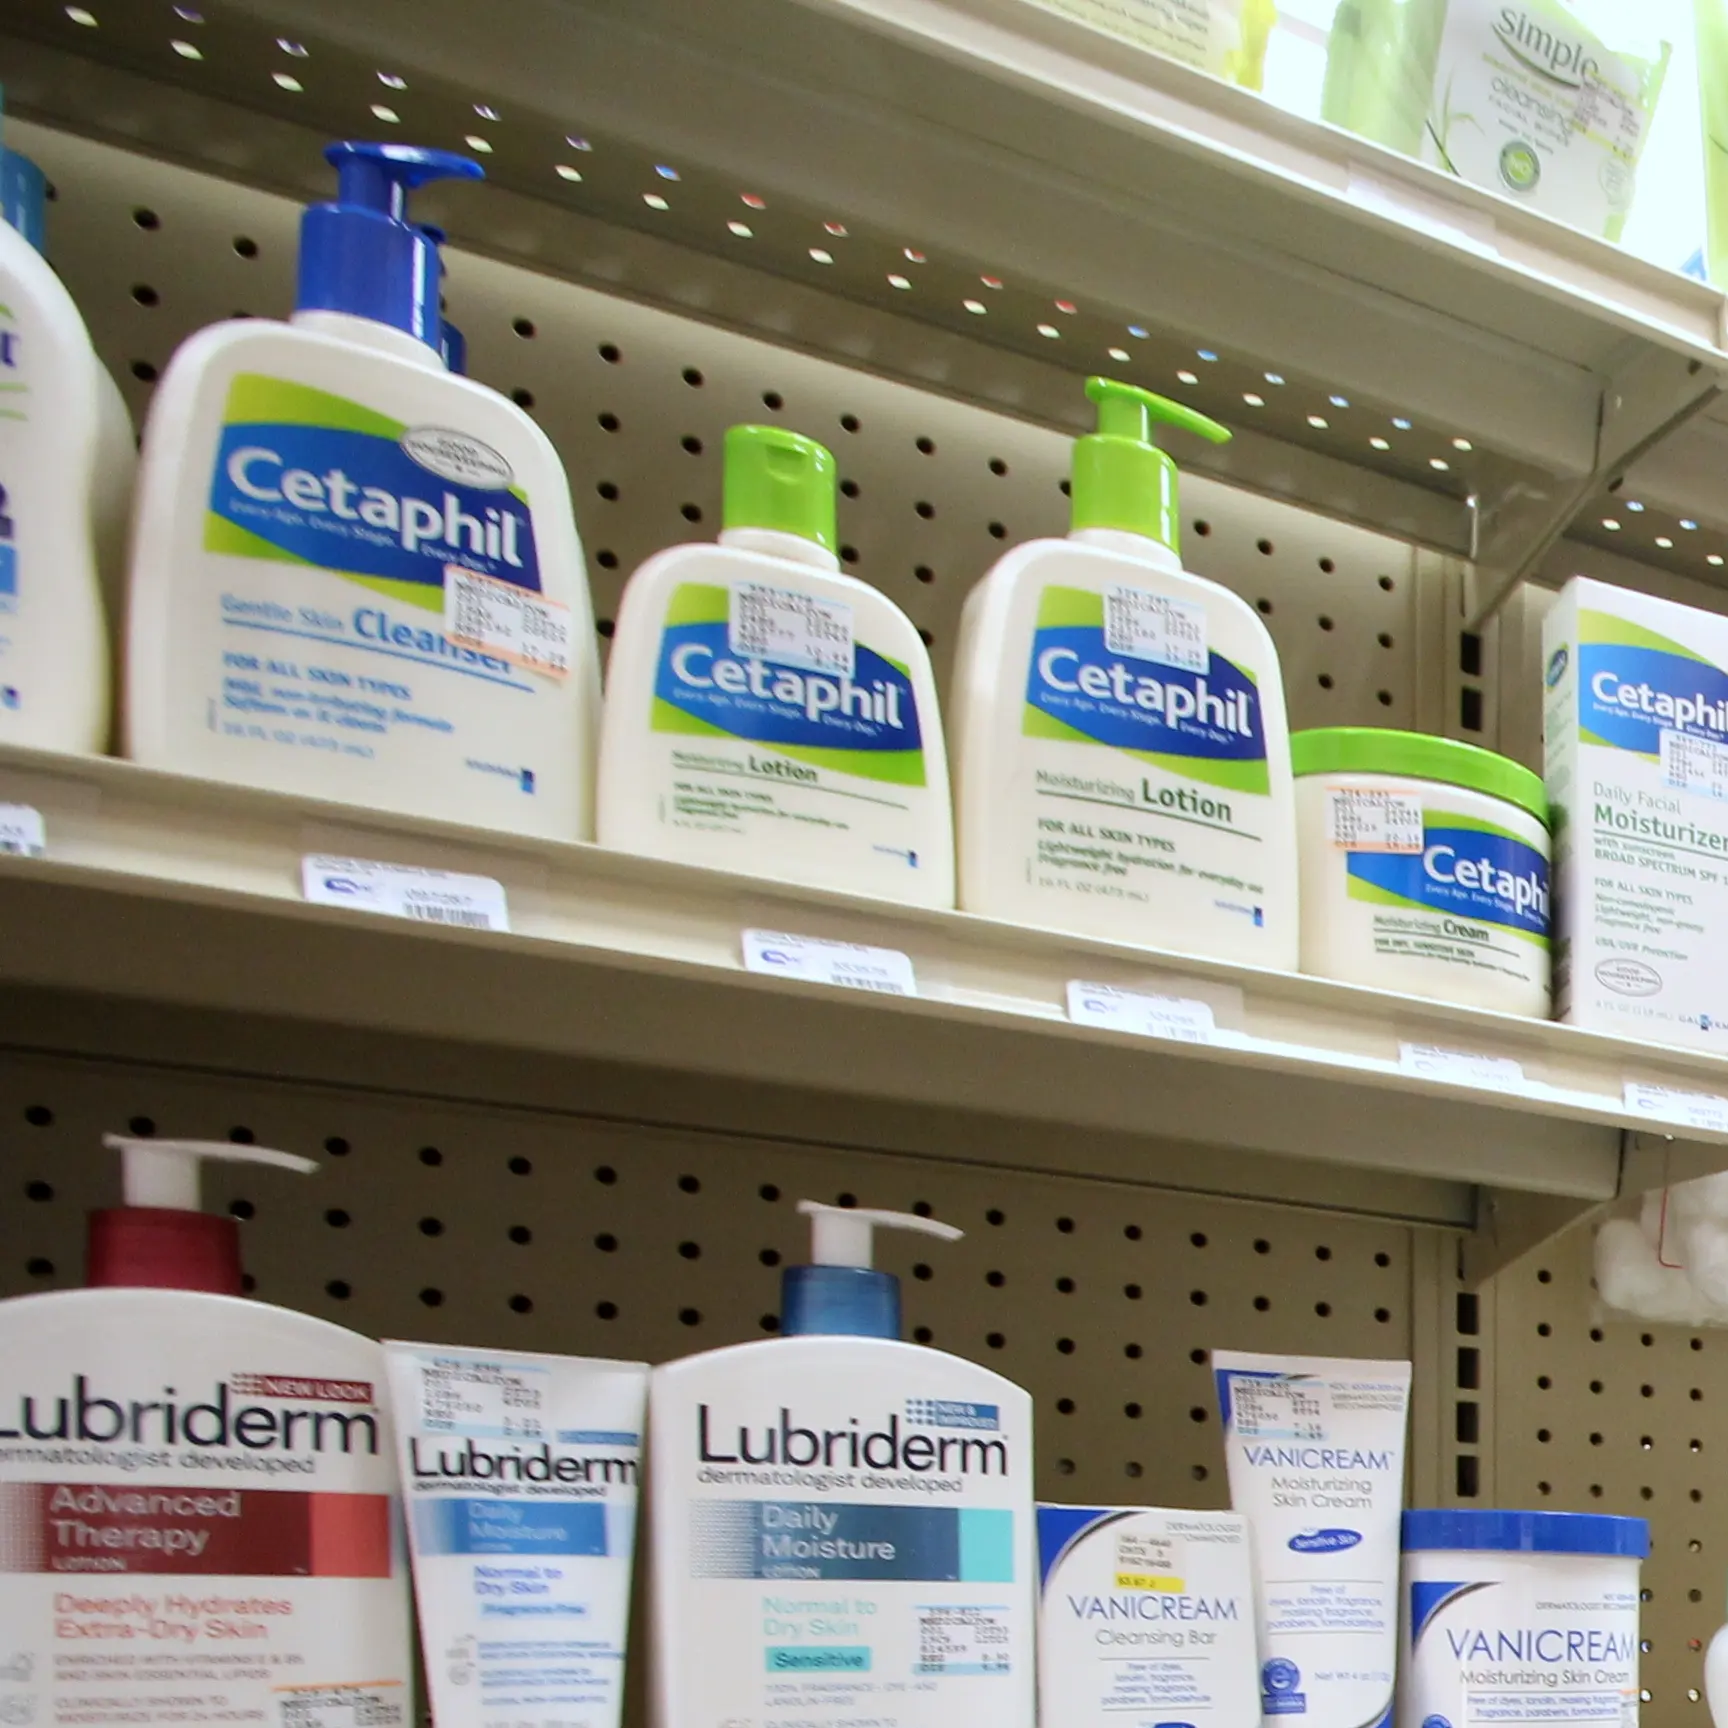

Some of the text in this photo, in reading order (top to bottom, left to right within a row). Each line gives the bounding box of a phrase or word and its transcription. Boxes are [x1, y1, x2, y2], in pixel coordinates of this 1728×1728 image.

[1499, 9, 1599, 92] Simple
[226, 444, 525, 568] Cetaphil
[670, 642, 904, 731] Cetaphil
[1037, 646, 1254, 738] Cetaphil
[749, 753, 819, 783] Lotion
[1035, 769, 1234, 823] Moisturizing Lotion
[1593, 782, 1682, 816] Daily Facial
[1037, 817, 1176, 853] FOR ALL SKIN TYPES
[1594, 849, 1636, 869] BROAD
[1637, 855, 1697, 879] SPECTRUM
[1699, 867, 1719, 883] SPF
[1443, 917, 1490, 942] Cream
[0, 1373, 380, 1456] ubriderm
[697, 1403, 1009, 1478] Lubriderm
[408, 1434, 640, 1488] Lubriderm
[1243, 1446, 1391, 1471] VANICREAM
[696, 1466, 964, 1494] dermatologist developed
[49, 1485, 243, 1520] Advanced
[1271, 1492, 1373, 1510] Skin Cream
[761, 1506, 839, 1535] Daily
[51, 1519, 211, 1556] Therapy
[760, 1531, 896, 1560] Moisture
[54, 1592, 295, 1620] Deeply Hydrates
[762, 1595, 878, 1617] Normal to
[1067, 1594, 1240, 1623] VANICREAM
[54, 1618, 270, 1643] Extra-Dry Skin
[762, 1616, 860, 1639] Dry Skin
[1095, 1628, 1219, 1649] Cleansing Bar
[773, 1650, 864, 1671] Sensitive
[1446, 1628, 1637, 1664] VANICREAM
[1459, 1668, 1630, 1688] Moisturizing Skin Cream
